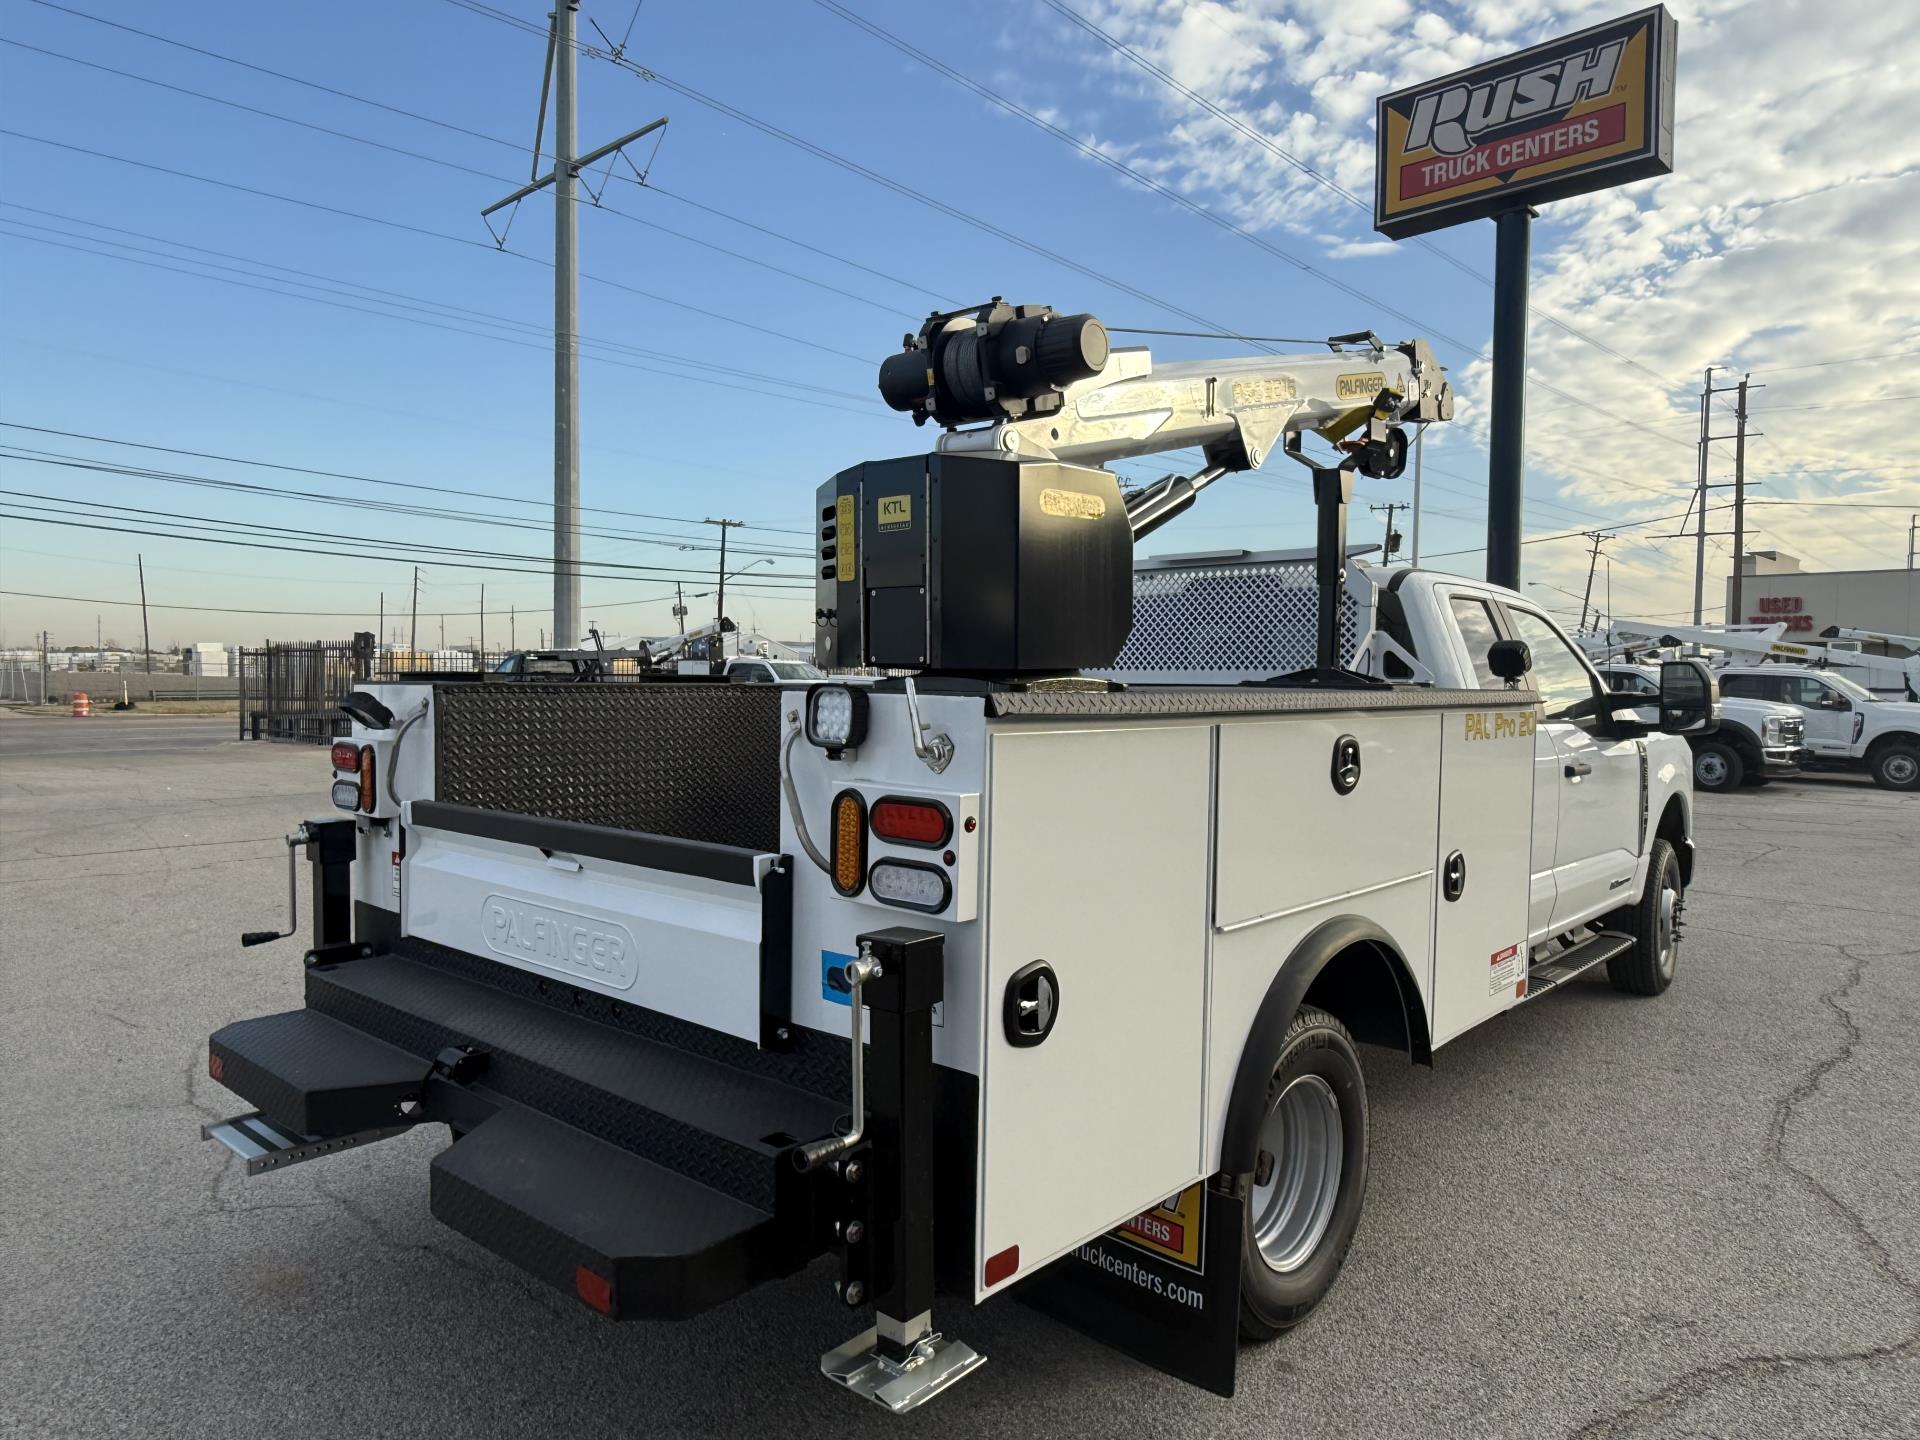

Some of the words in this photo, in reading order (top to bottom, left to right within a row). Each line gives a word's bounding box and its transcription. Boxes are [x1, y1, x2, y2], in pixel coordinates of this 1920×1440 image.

[1402, 37, 1628, 156] RUSH
[1421, 148, 1490, 187] TRUCK
[1496, 119, 1600, 167] CENTERS
[1340, 377, 1383, 396] PALFINGER
[883, 500, 906, 515] KTL
[1759, 597, 1803, 613] USED
[1465, 713, 1490, 741] PAL
[1495, 712, 1516, 739] Pro
[489, 905, 626, 978] PALFINGER
[1125, 1215, 1170, 1241] NTERS
[1070, 1245, 1203, 1310] uckcenters.com
